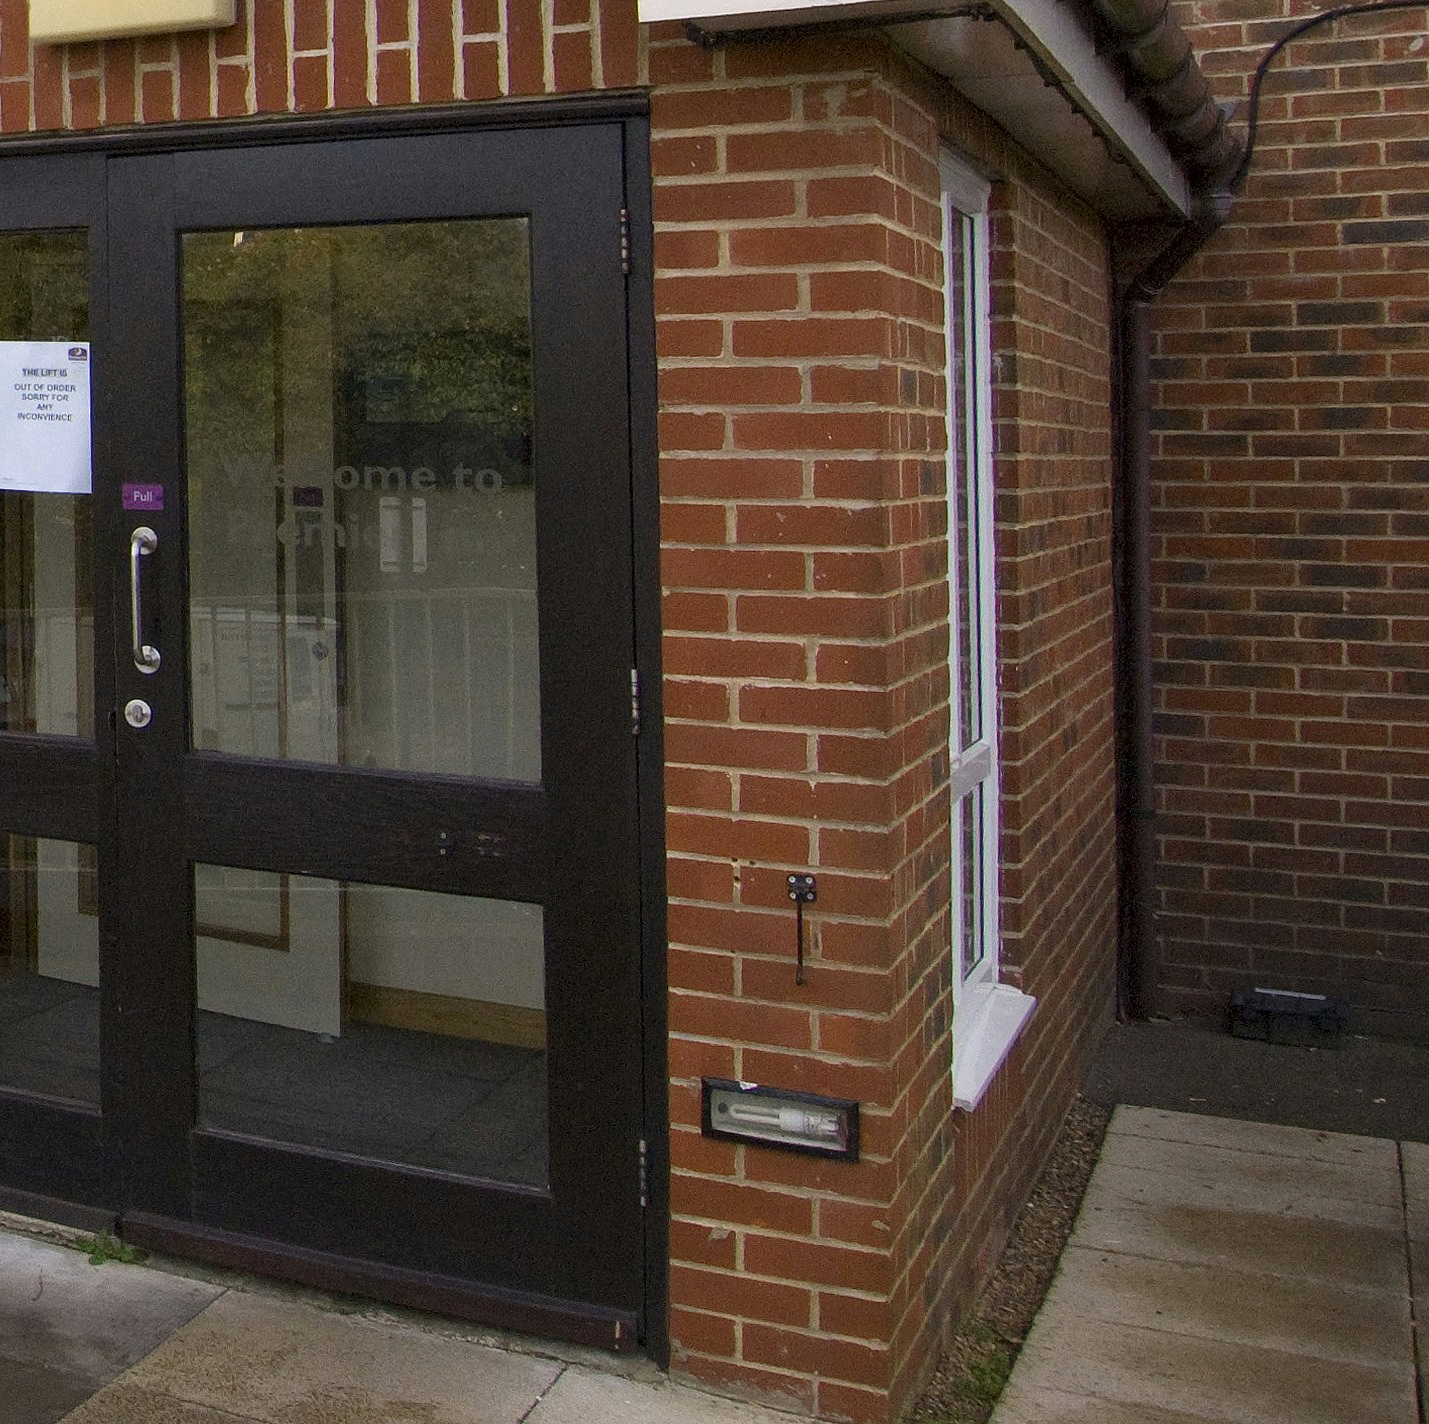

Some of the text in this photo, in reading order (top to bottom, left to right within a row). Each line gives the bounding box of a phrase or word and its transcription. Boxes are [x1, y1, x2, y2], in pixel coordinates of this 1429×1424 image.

[22, 368, 68, 378] THE LIFT IS
[14, 383, 76, 393] OUT OF ORDER
[21, 393, 69, 402] SORRY FOR
[36, 403, 53, 411] ANY
[17, 412, 72, 422] INCONVIENCE
[453, 461, 503, 495] to
[133, 490, 153, 502] Pull
